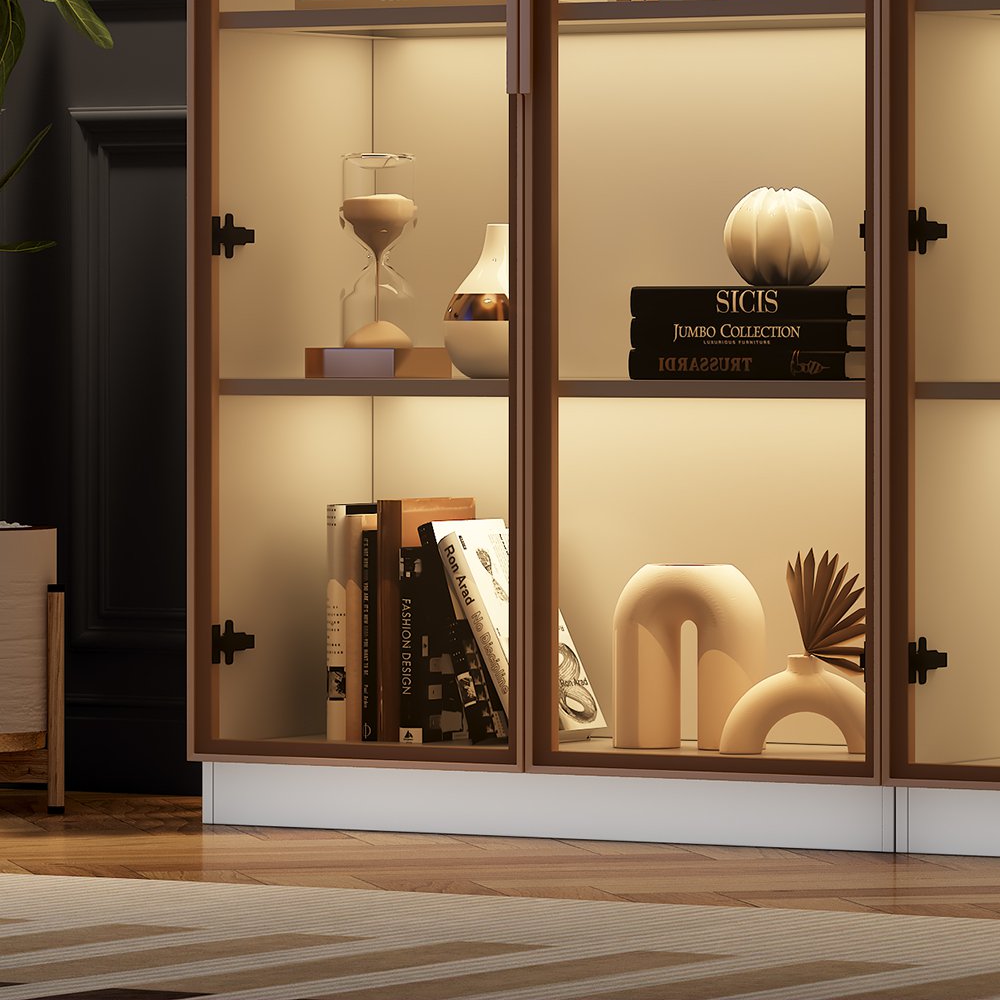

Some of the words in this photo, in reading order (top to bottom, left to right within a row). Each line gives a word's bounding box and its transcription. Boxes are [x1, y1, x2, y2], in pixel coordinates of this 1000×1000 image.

[716, 290, 778, 314] SICIS
[673, 324, 716, 342] JUMBO
[720, 324, 800, 338] COLLECTION
[402, 598, 412, 648] FASHION
[444, 544, 459, 573] Ron
[456, 573, 475, 606] Arad
[470, 610, 484, 632] No
[480, 632, 509, 696] Discipline
[402, 652, 412, 695] DESIGN
